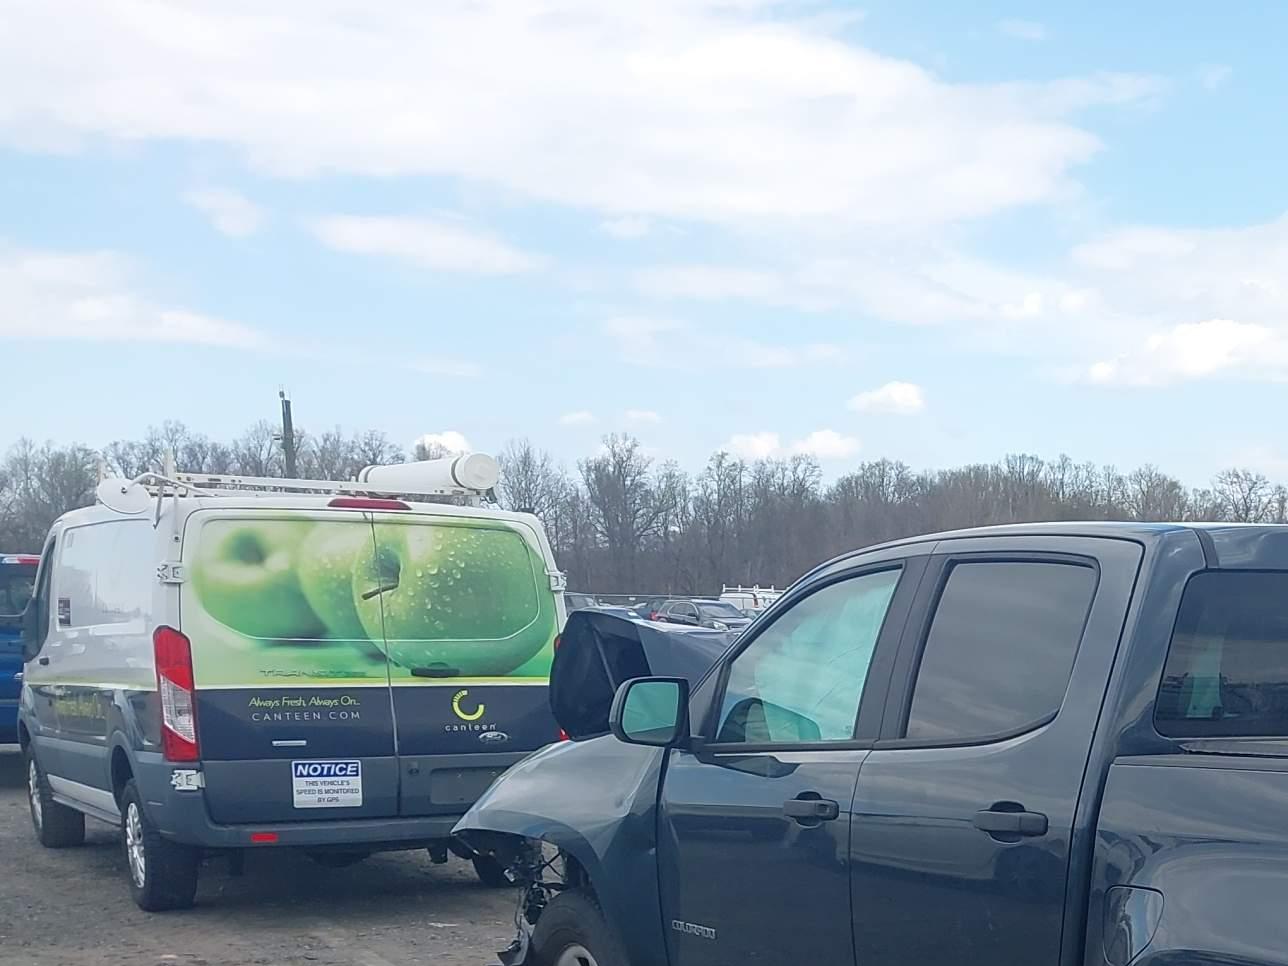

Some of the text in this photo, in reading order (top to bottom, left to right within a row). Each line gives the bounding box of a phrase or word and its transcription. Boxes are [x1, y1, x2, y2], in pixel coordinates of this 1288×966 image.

[248, 696, 280, 709] Always
[309, 696, 339, 708] Always
[296, 763, 359, 777] NOTICE
